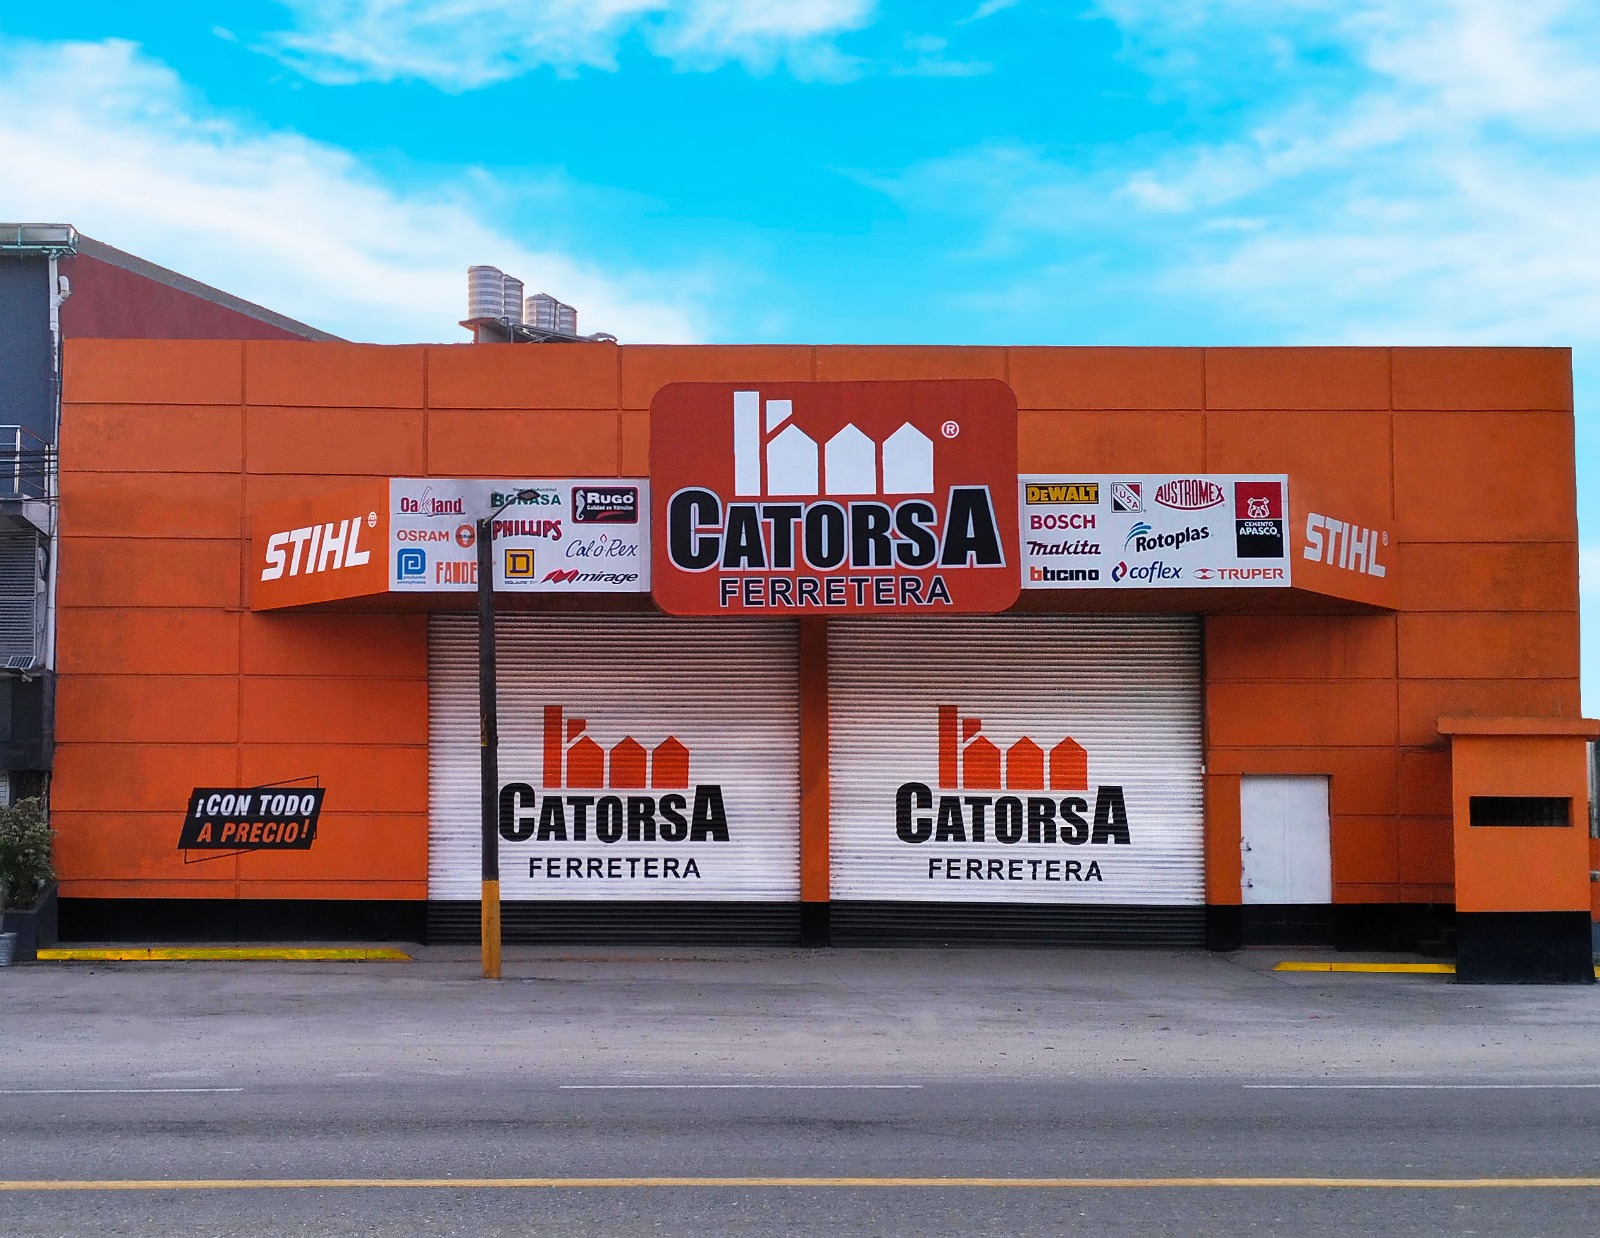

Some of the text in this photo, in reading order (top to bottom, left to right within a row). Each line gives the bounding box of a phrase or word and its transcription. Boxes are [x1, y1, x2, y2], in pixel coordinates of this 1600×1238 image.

[400, 486, 463, 517] Oakland
[586, 492, 634, 504] RUGO
[1115, 486, 1139, 509] IUSA
[1155, 479, 1225, 507] AUSTROMEX
[492, 519, 563, 541] PHILLIPS
[667, 485, 1006, 572] CATORSA
[1030, 514, 1096, 530] BOSCH
[1239, 527, 1278, 536] APASCO
[396, 529, 450, 542] OSRAM
[1136, 526, 1210, 553] Rotoplas
[1303, 512, 1386, 578] STIHL
[261, 516, 371, 581] STIHL
[576, 570, 639, 585] mirage
[1030, 566, 1100, 581] bticino
[1129, 561, 1183, 583] coflex
[1217, 568, 1285, 580] TRUPER
[719, 575, 953, 607] FERRETERA
[195, 793, 316, 818] ¡CON TODO
[499, 782, 731, 844] CATORSA
[895, 782, 1132, 845] CATORSA
[196, 819, 310, 843] A PRECIO!
[529, 857, 701, 879] FERRETERA
[928, 858, 1104, 882] FERRETERA
